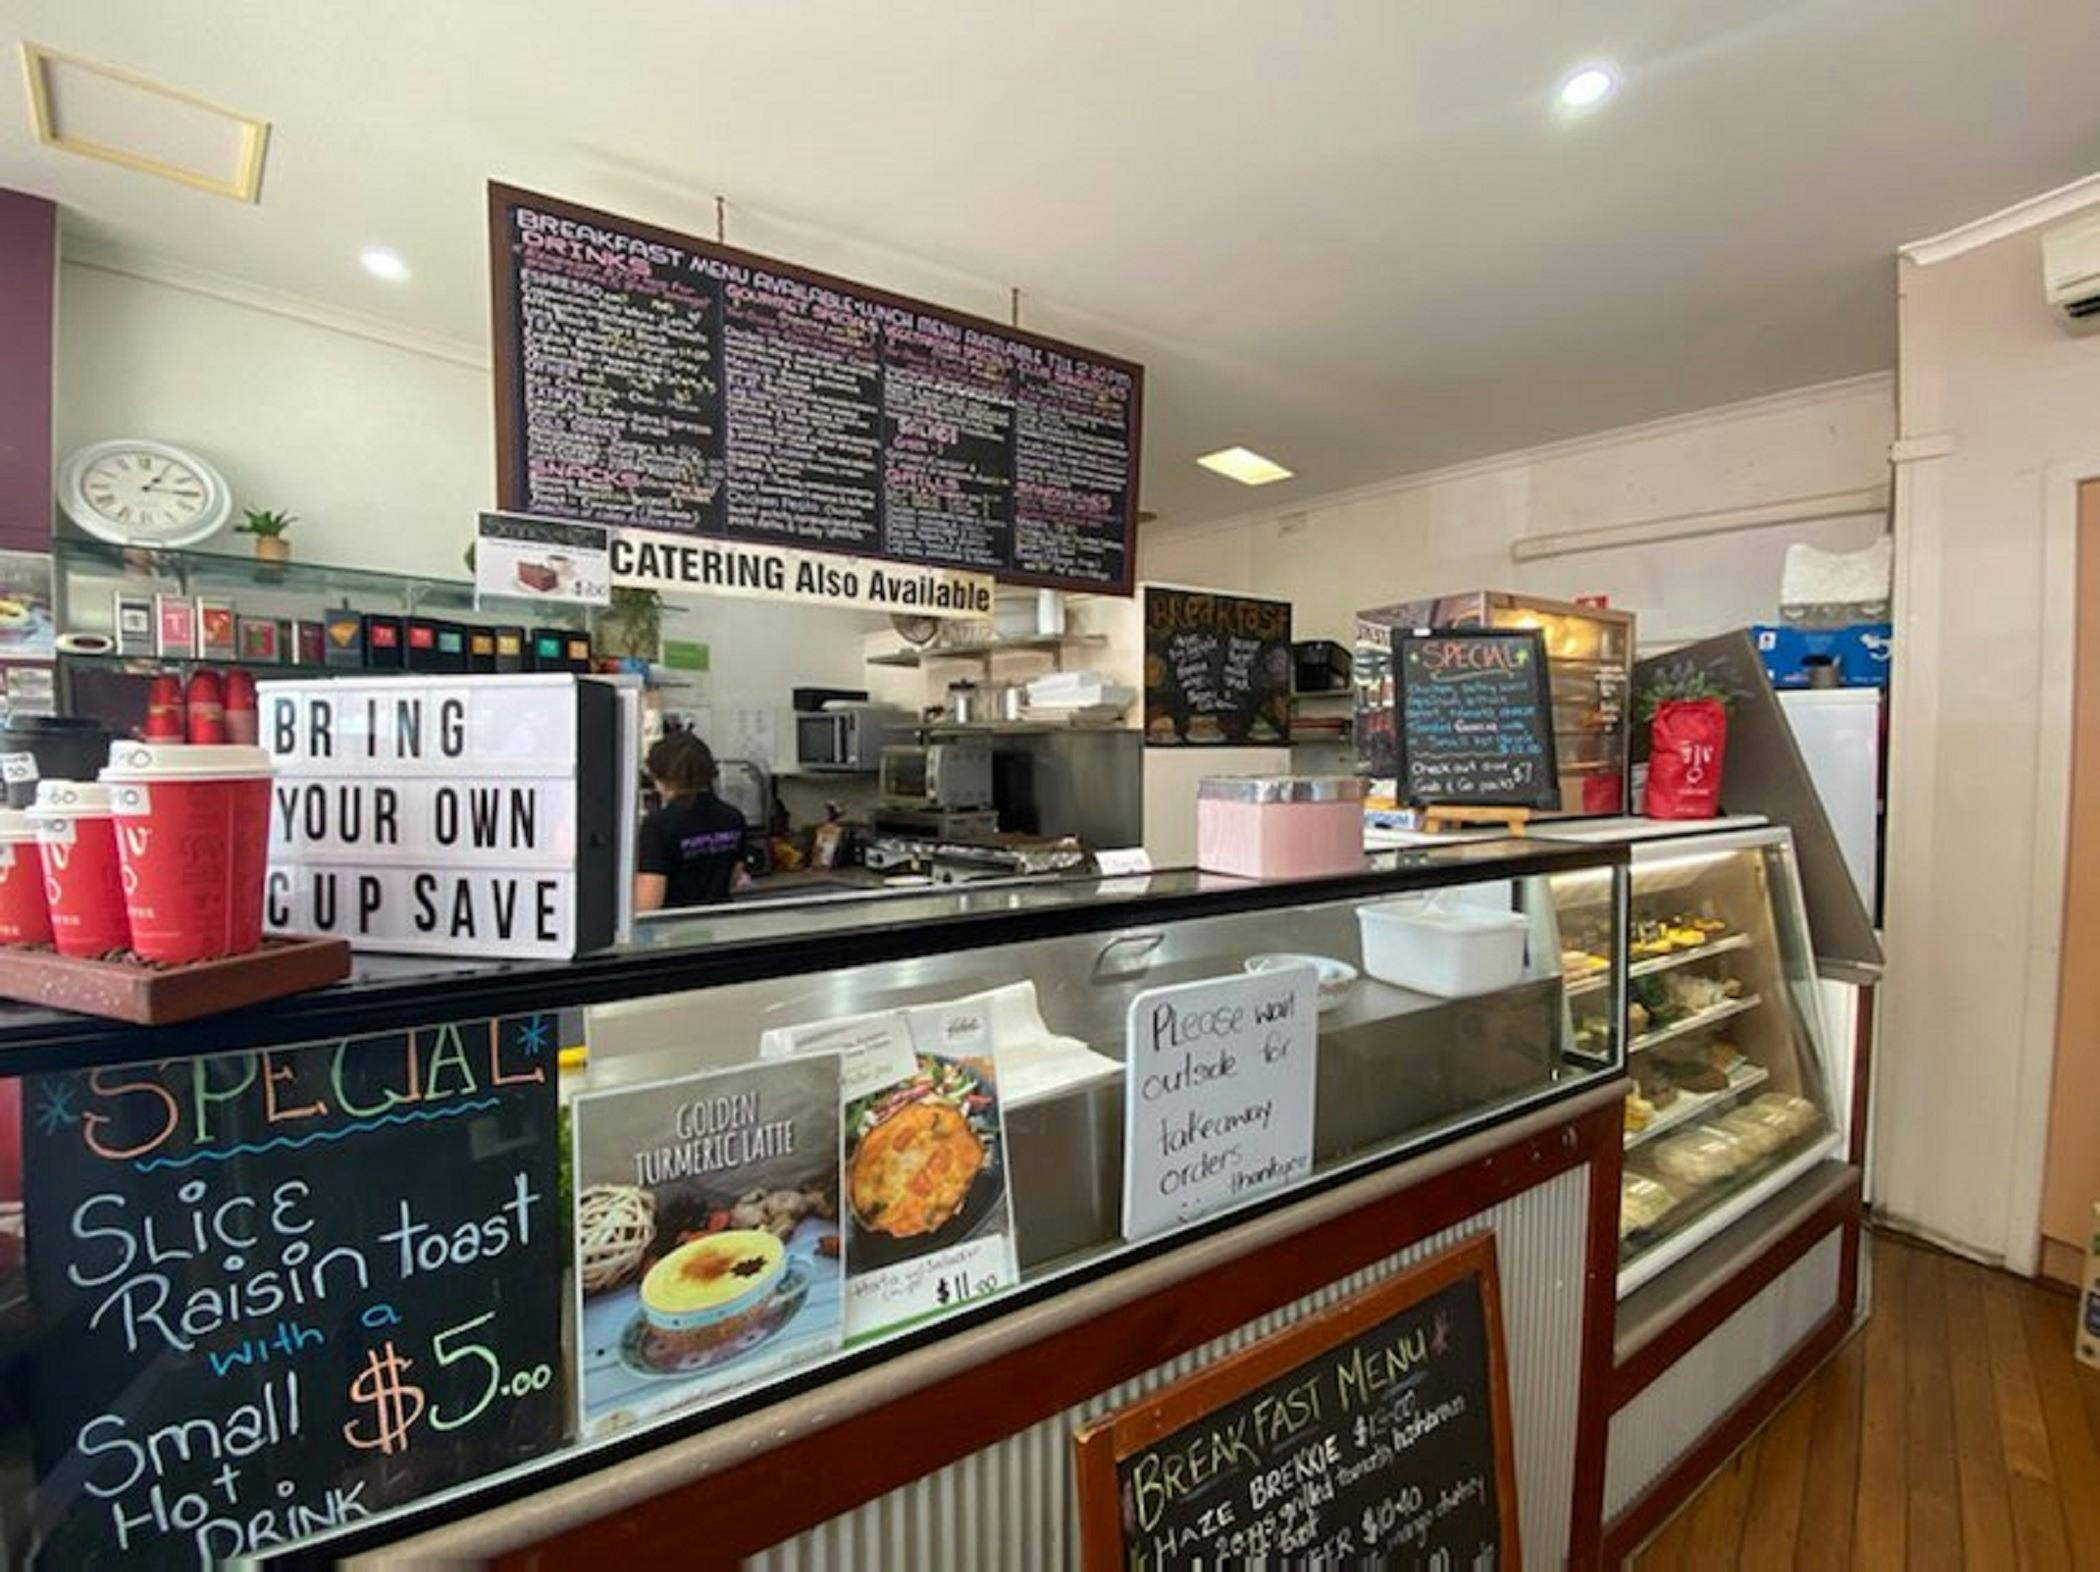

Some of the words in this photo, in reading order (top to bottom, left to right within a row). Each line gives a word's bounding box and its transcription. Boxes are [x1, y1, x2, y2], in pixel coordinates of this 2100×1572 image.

[516, 208, 685, 268] BREAKFAST
[690, 257, 751, 285] MENU
[520, 230, 651, 277] DRINKS
[610, 538, 785, 591] CATERING
[795, 560, 859, 599] Also
[868, 568, 992, 613] Available
[1421, 642, 1520, 672] SPECIAL
[276, 783, 398, 844] YOUR
[434, 787, 536, 850] OWN
[267, 871, 382, 934] CUP
[413, 873, 559, 942] SAVE
[1152, 1002, 1244, 1053] Please
[1254, 993, 1295, 1025] wait
[82, 1017, 545, 1161] SPECIAL
[1141, 1049, 1237, 1101] outside
[1261, 1030, 1292, 1064] for
[676, 1091, 760, 1140] GOLDEN
[1161, 1099, 1273, 1157] takeaway
[634, 1130, 742, 1188] TURMERIC
[742, 1119, 795, 1163] LATTE
[1159, 1144, 1243, 1196] orders
[88, 1240, 369, 1355] Raisin
[379, 1171, 541, 1279] toast
[208, 1319, 325, 1378] with
[360, 1303, 401, 1331] a
[76, 1371, 301, 1498] Small
[1132, 1374, 1322, 1534] BREAKFAST
[1336, 1327, 1428, 1414] MENU
[111, 1463, 242, 1550] Hot
[1153, 1500, 1237, 1560] HAZE
[1248, 1433, 1343, 1512] BREKKIE
